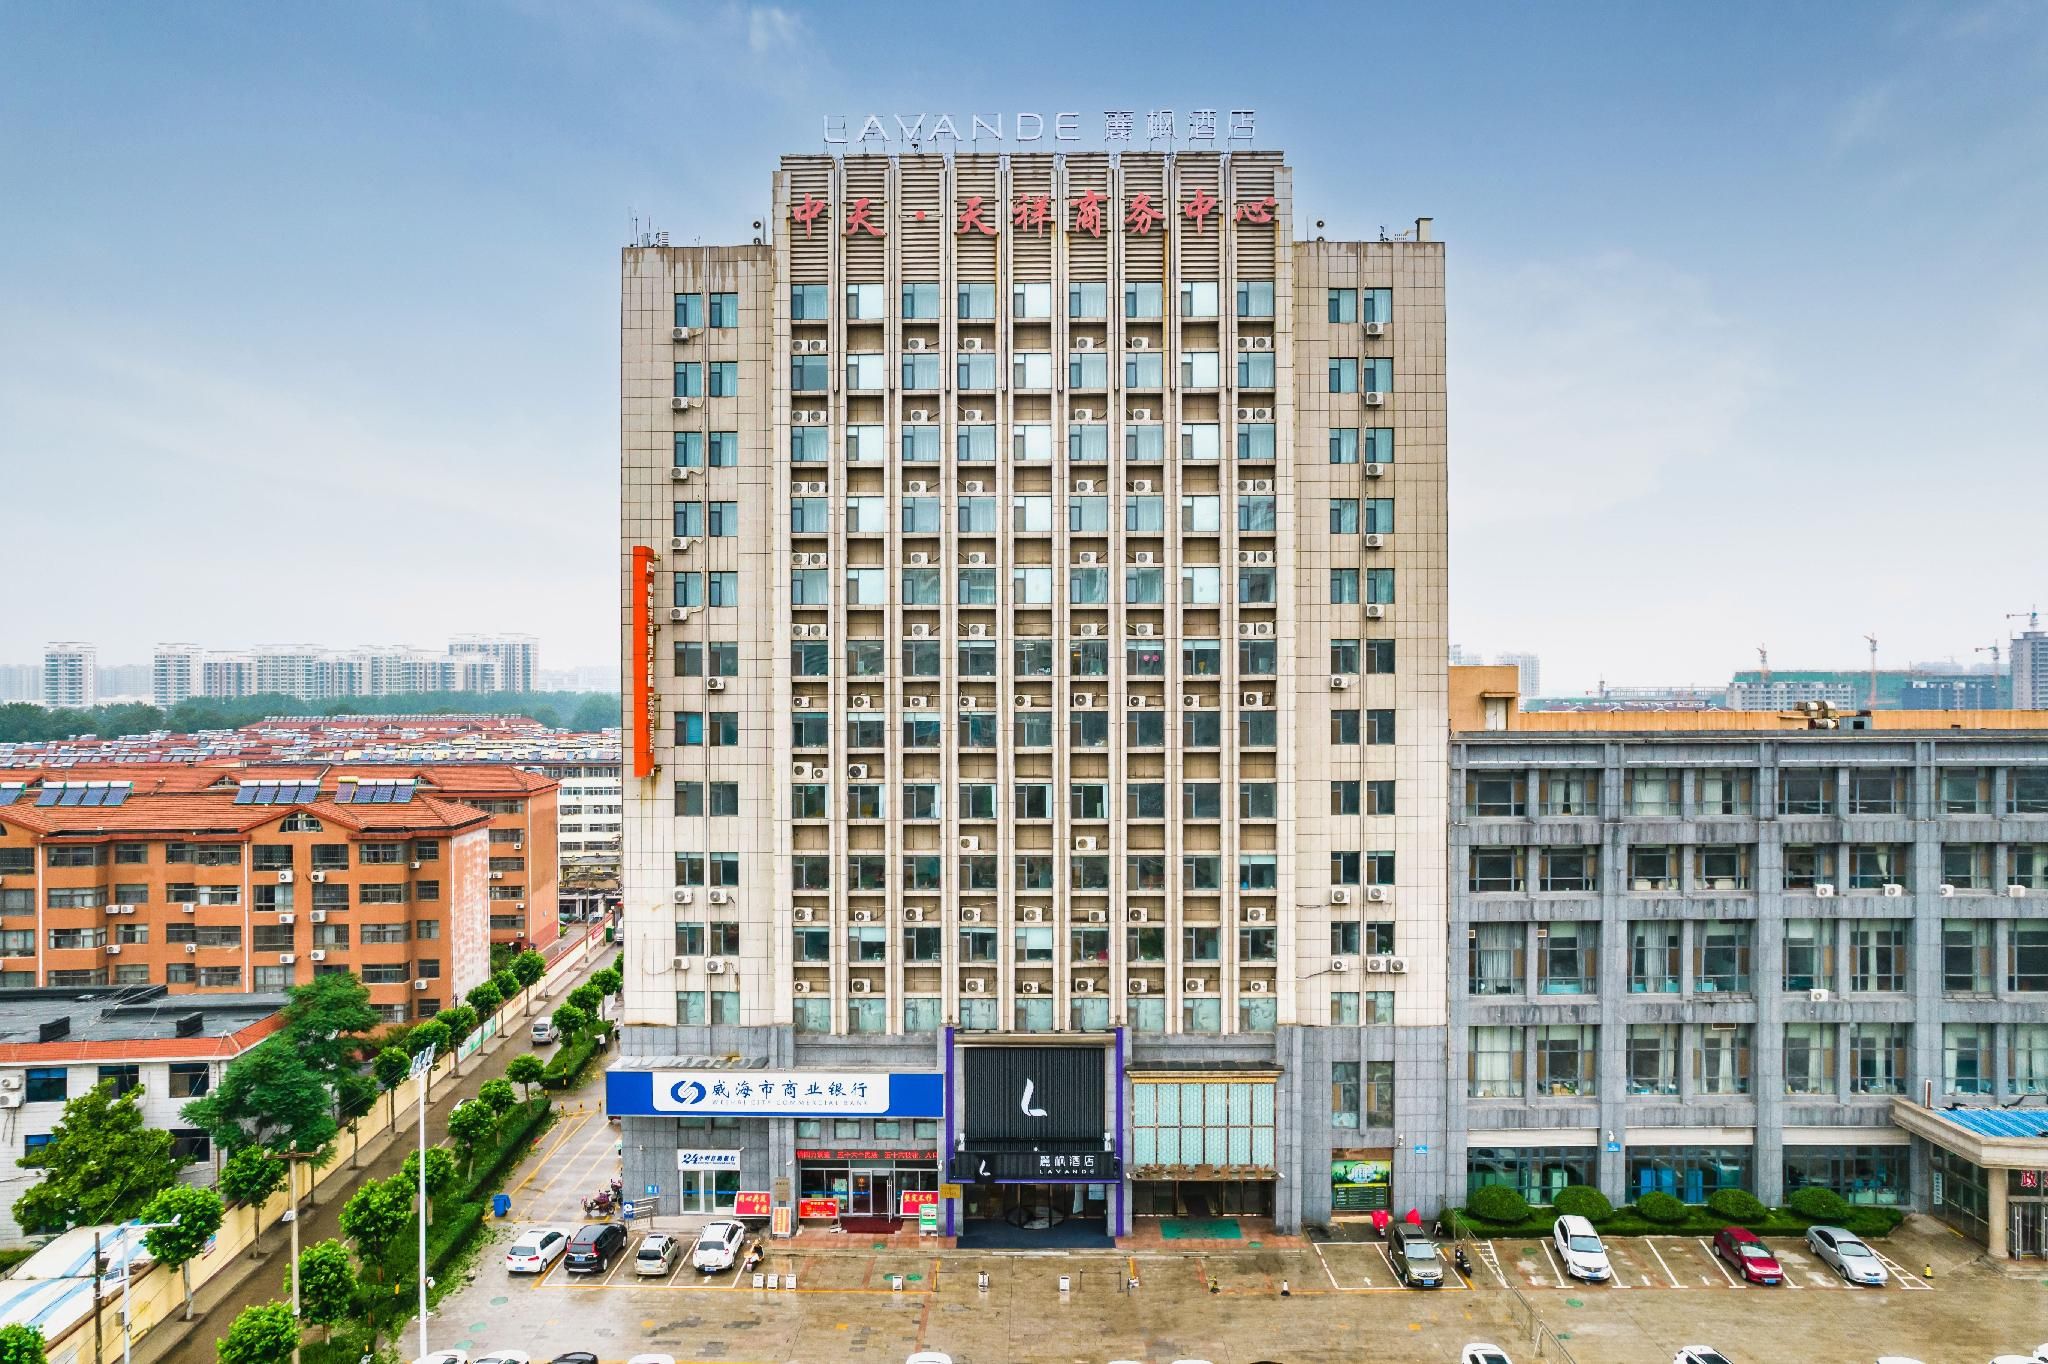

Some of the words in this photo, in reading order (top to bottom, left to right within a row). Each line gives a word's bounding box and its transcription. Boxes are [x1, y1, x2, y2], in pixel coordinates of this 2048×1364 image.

[823, 112, 1081, 143] LAVANDE
[712, 1080, 868, 1099] 威海市商业银行
[2021, 1169, 2048, 1187] 政
